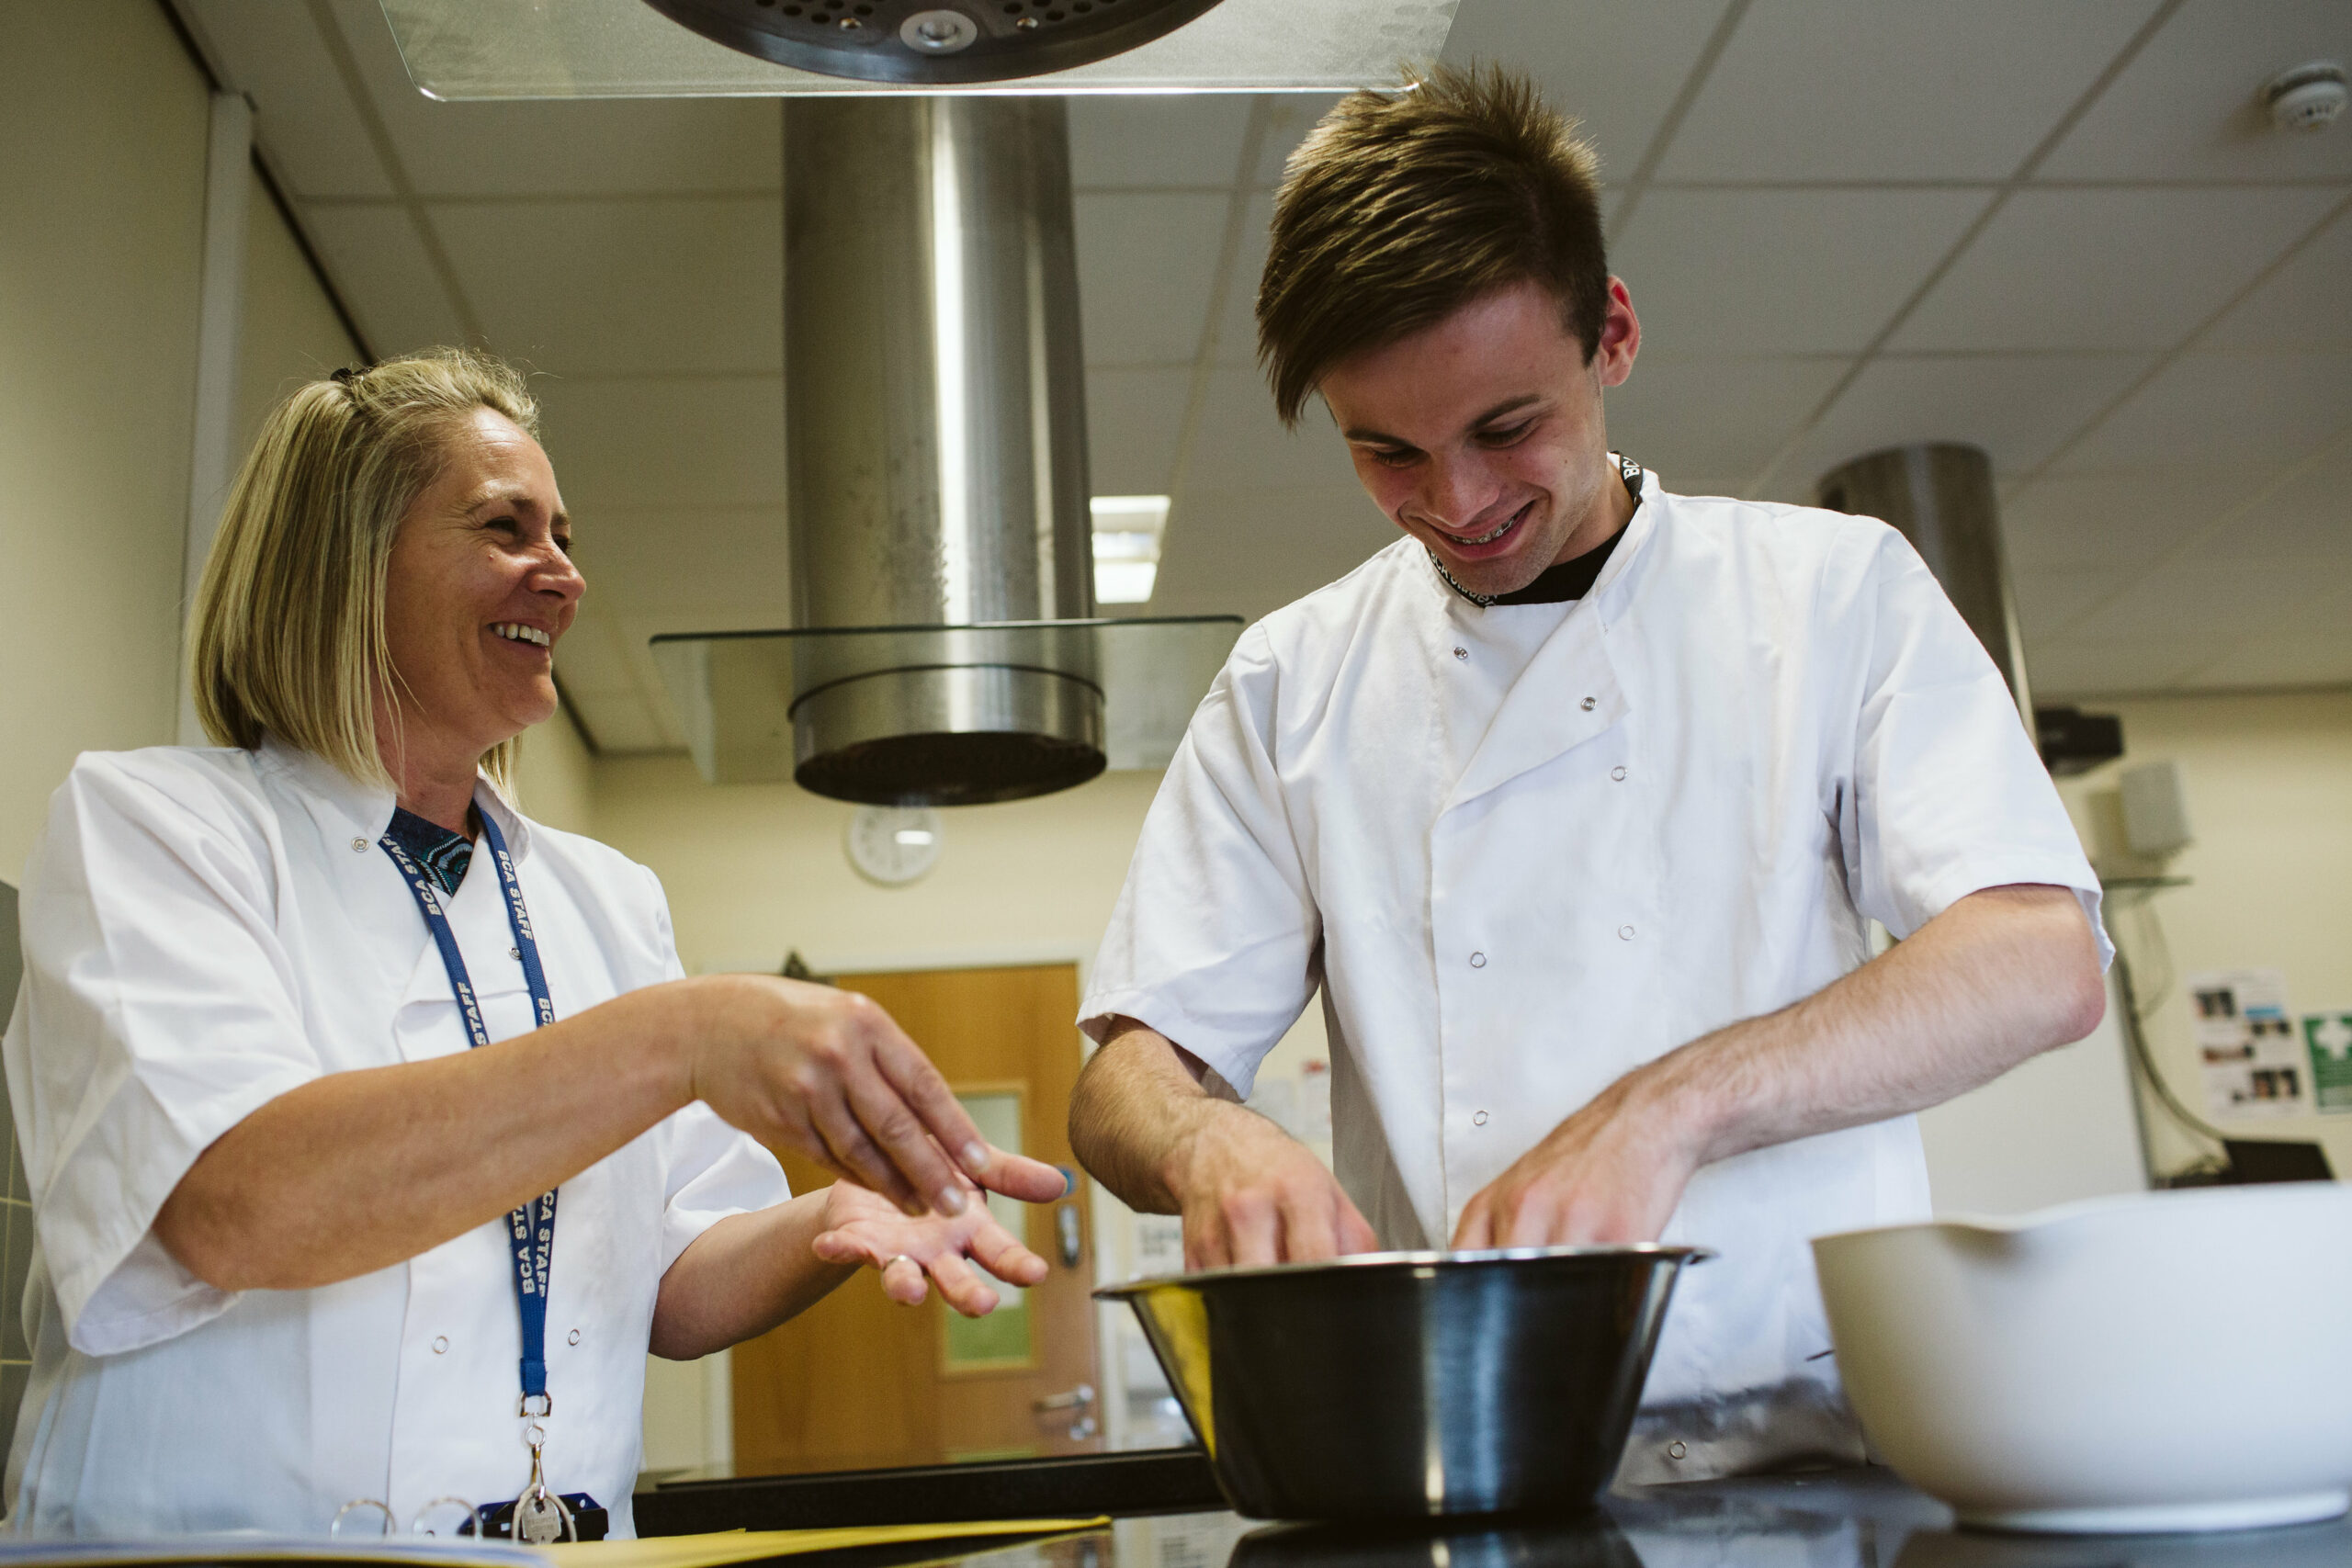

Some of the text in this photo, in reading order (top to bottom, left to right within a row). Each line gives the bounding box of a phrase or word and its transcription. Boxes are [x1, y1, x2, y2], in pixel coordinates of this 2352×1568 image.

[414, 879, 442, 916] BCA
[497, 850, 533, 941] BCA STAFF
[457, 981, 487, 1045] STAFF
[537, 998, 554, 1026] BC
[540, 1190, 555, 1222] CA
[518, 1245, 535, 1294] BCA
[536, 1227, 550, 1297] STAFF
